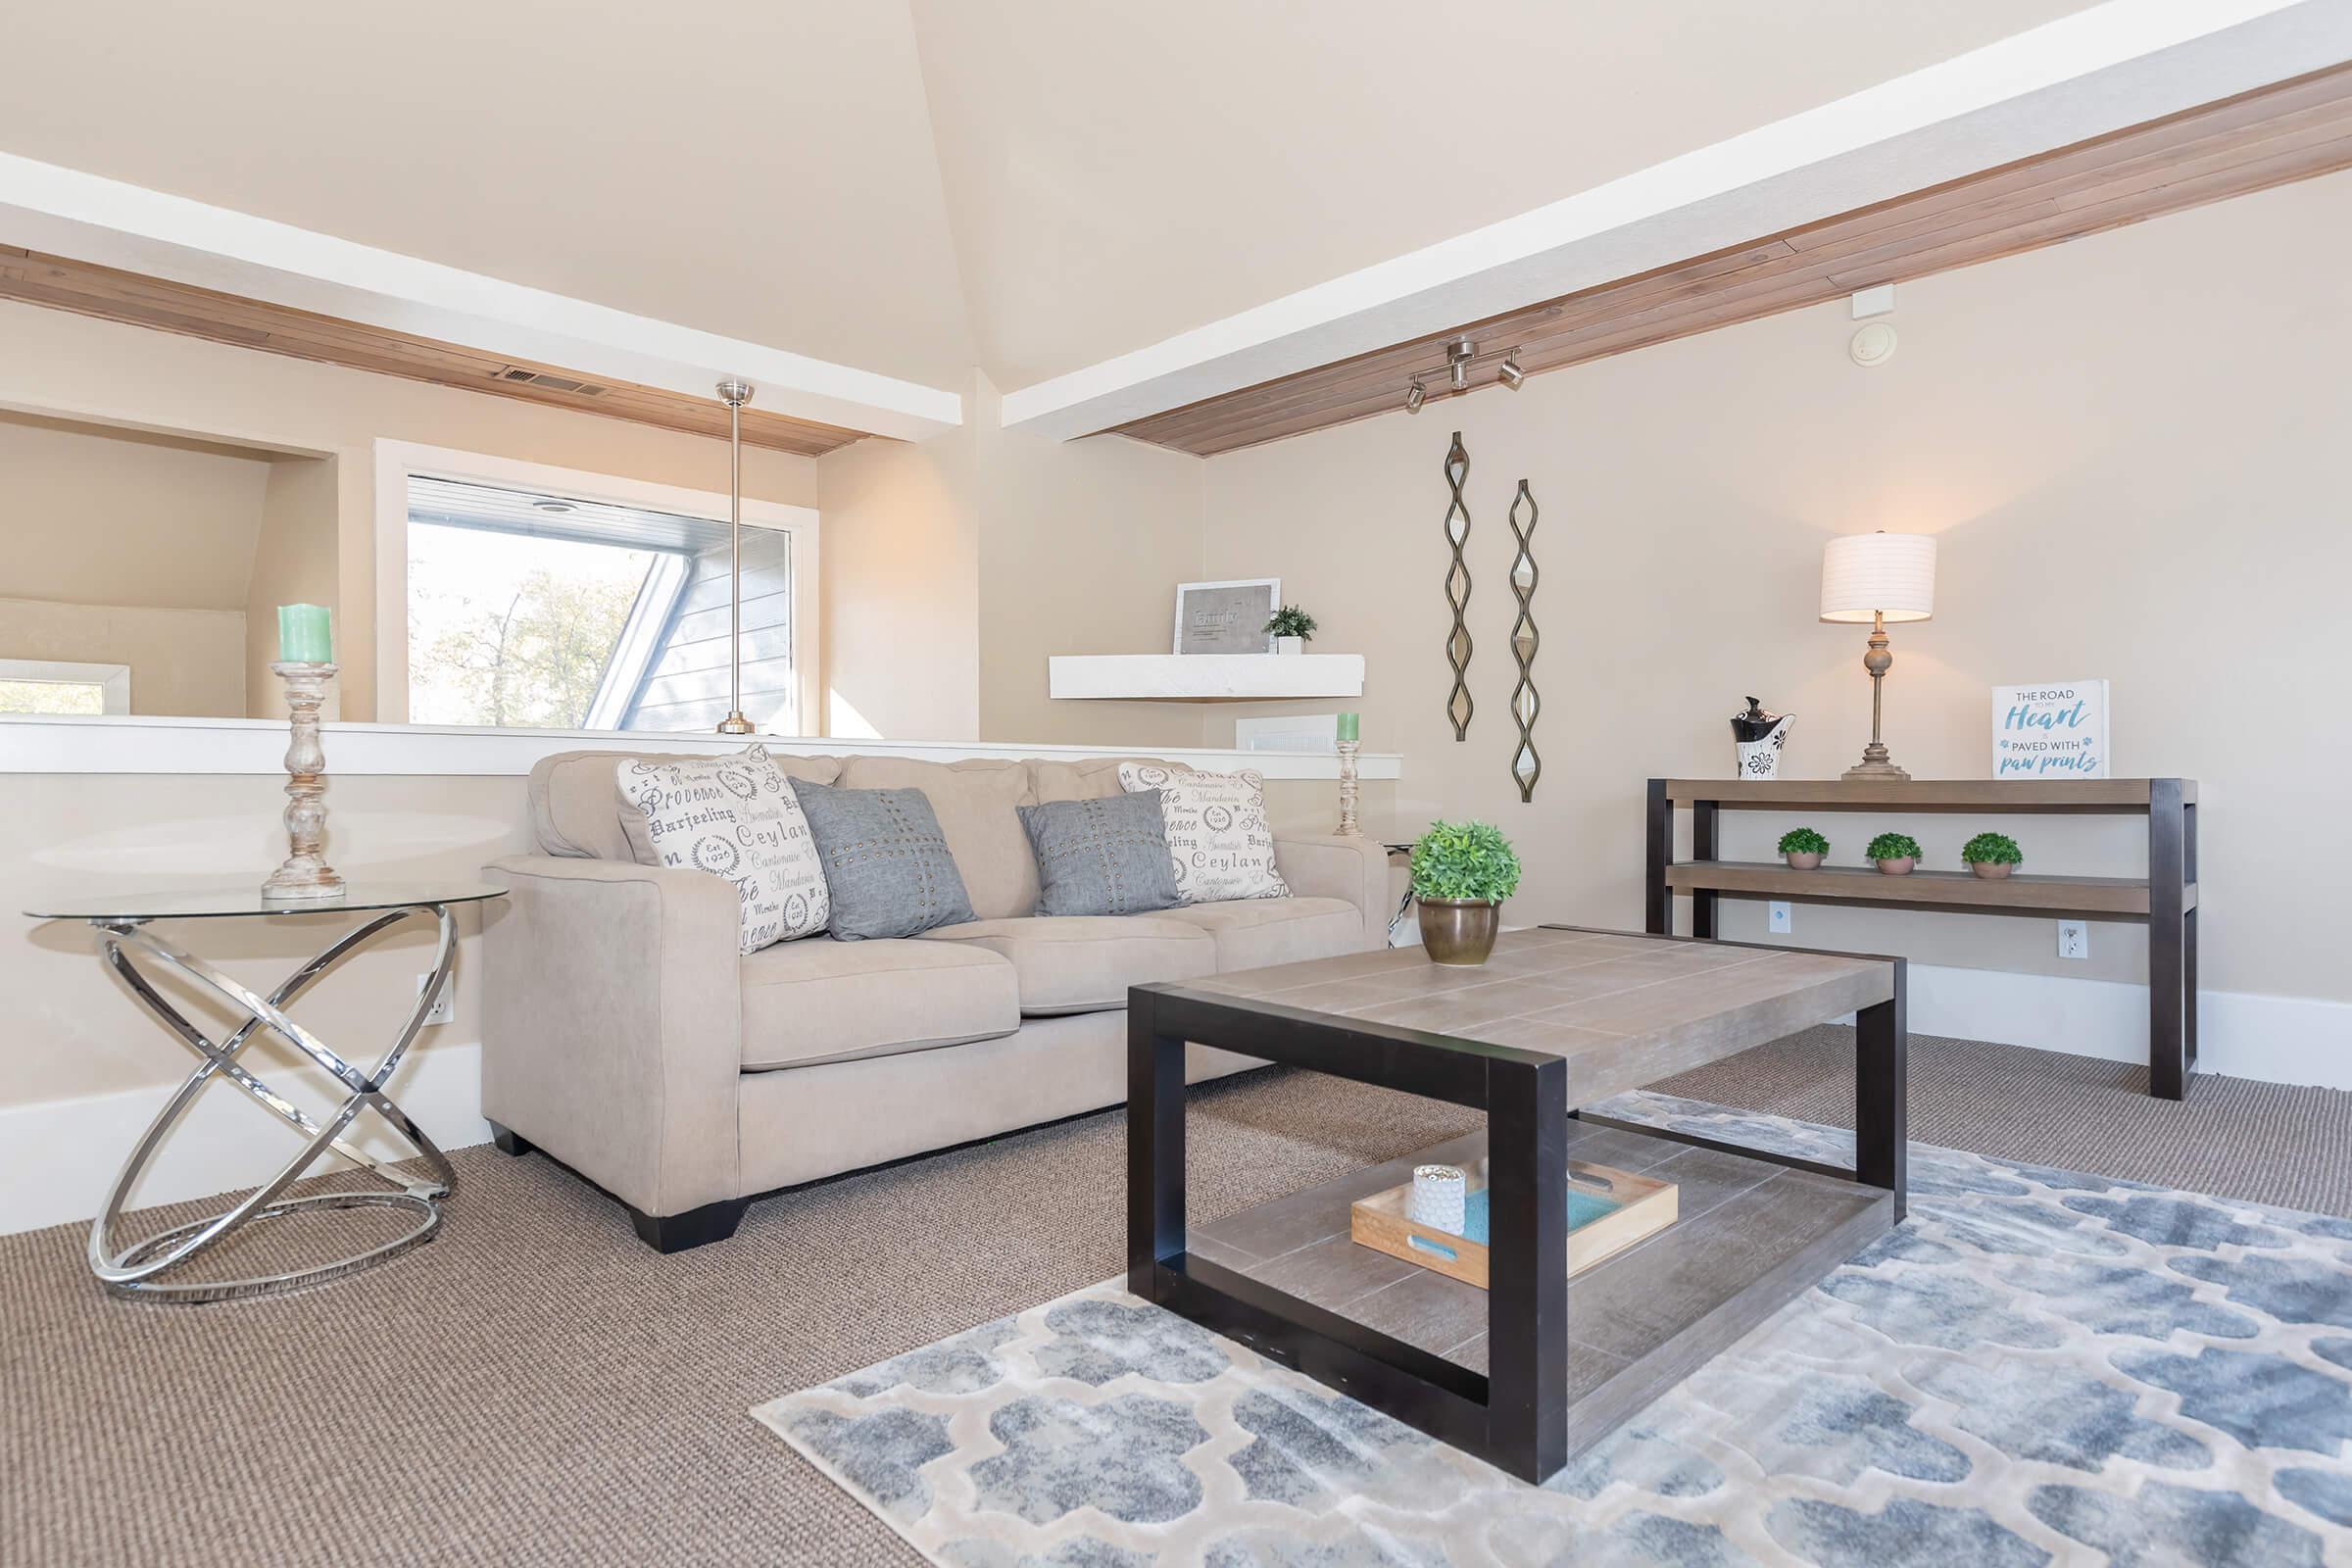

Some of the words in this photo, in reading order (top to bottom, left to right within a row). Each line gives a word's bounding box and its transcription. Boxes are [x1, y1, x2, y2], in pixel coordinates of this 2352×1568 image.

[2016, 692, 2037, 702] THE
[2039, 690, 2075, 701] ROAD
[2004, 700, 2091, 730] Heart
[2012, 742, 2048, 752] PAVED
[2050, 741, 2080, 751] WITH
[1999, 755, 2039, 775] paw
[2039, 751, 2101, 775] prints
[650, 807, 738, 844] Darjeeling
[736, 821, 808, 848] Ceylan
[1192, 851, 1262, 871] Ceylan
